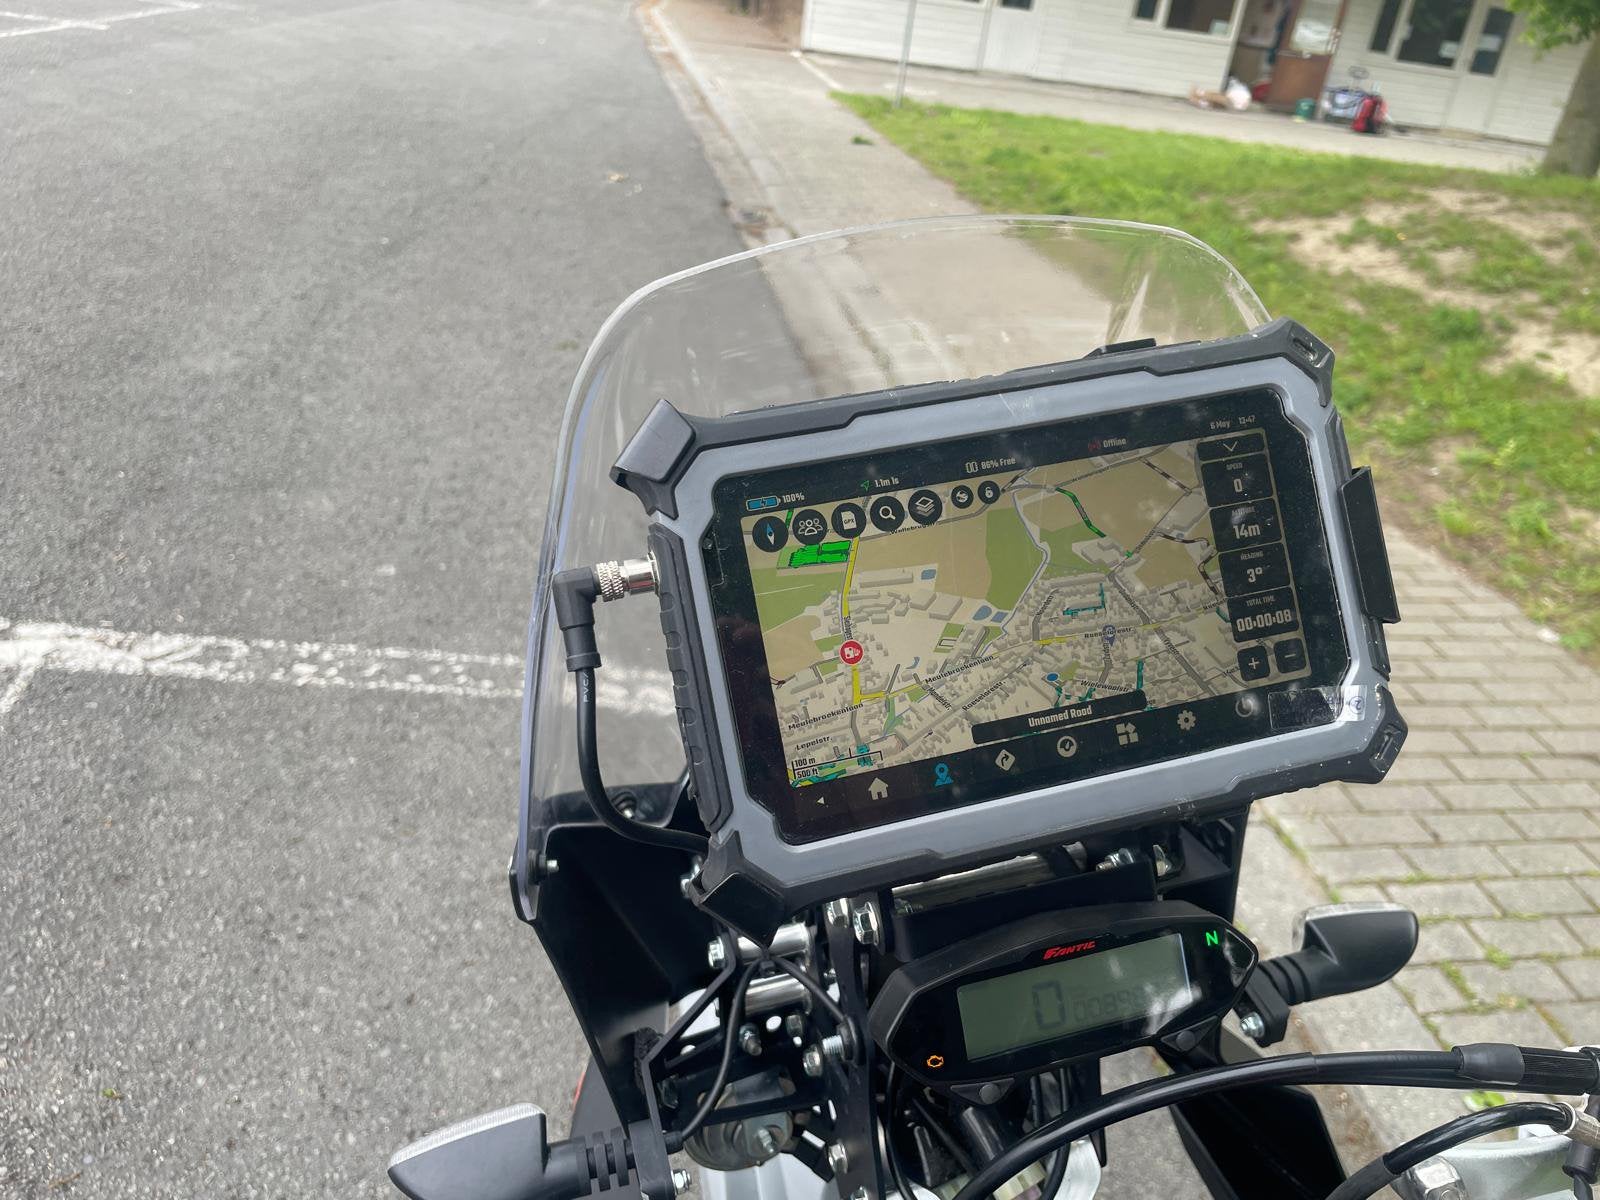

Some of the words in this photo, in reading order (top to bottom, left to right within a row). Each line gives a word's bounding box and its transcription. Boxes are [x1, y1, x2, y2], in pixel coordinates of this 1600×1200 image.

[1103, 437, 1127, 448] Offline
[982, 459, 998, 470] 86%
[1000, 456, 1016, 467] Free
[1234, 478, 1243, 494] 0
[782, 492, 804, 503] 100%
[844, 518, 855, 526] GPX
[1233, 522, 1260, 538] 14m
[1246, 597, 1262, 608] TOTAL
[1262, 595, 1276, 604] TIME
[1236, 608, 1292, 632] 00:00:08
[1028, 710, 1068, 728] Unnamed
[1069, 705, 1092, 721] Road
[795, 758, 808, 767] 100
[808, 757, 816, 765] m
[797, 768, 811, 779] 500
[812, 767, 818, 776] ft
[1206, 930, 1218, 946] N
[1043, 940, 1096, 960] FANTIC
